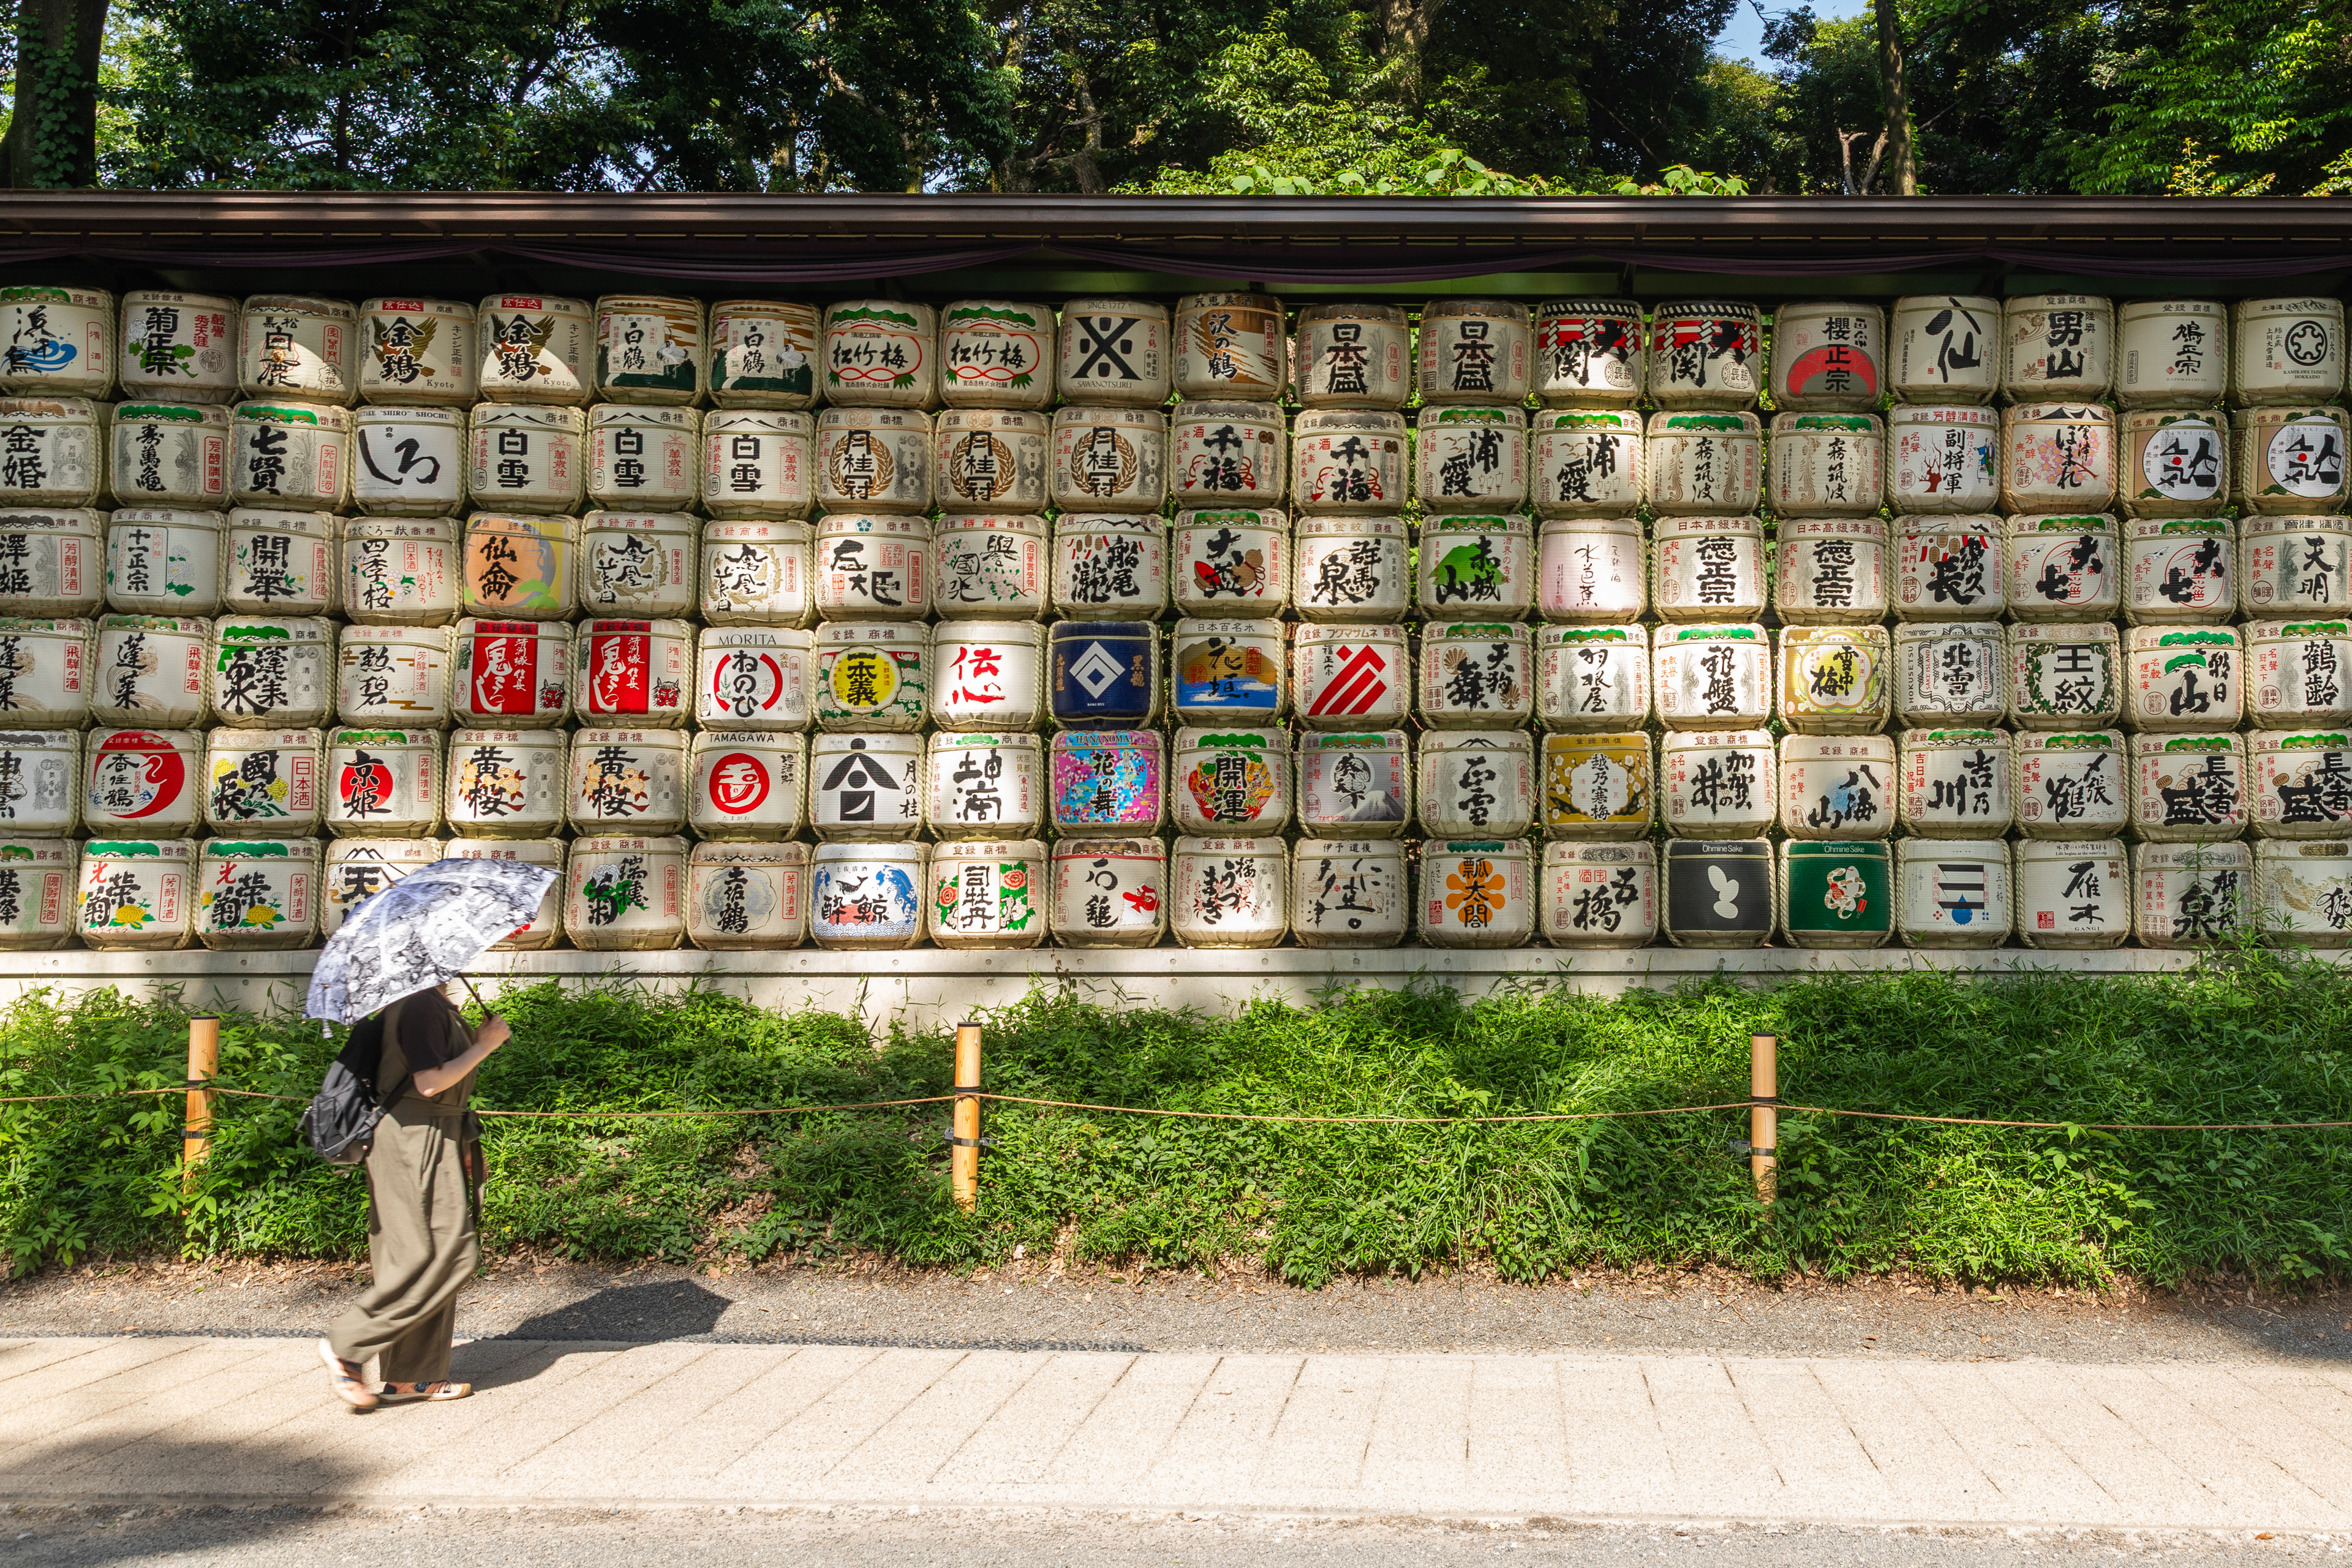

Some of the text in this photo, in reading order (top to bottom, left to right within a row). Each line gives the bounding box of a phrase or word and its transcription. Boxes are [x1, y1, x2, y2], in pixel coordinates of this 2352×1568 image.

[263, 317, 297, 328] 黒松
[385, 300, 422, 311] 京仕込
[502, 298, 540, 309] 京仕込
[1196, 295, 1252, 307] 天恵美酒
[2047, 295, 2086, 305] 登録商標
[2085, 312, 2095, 333] 陸奥
[145, 307, 178, 376] 菊正宗
[258, 326, 300, 387] 白鹿
[451, 325, 462, 365] キンシ正宗
[624, 322, 644, 370] 白鶴
[742, 326, 765, 374] 白鶴
[832, 340, 908, 369] 松竹梅
[950, 338, 1027, 369] 松竹梅
[1208, 313, 1238, 379] 沢の鶴
[1326, 323, 1370, 394] 日本盛
[1452, 320, 1496, 392] 日本盛
[1822, 317, 1851, 392] 櫻正宗
[1901, 331, 1910, 383] 八戸酒造株式会社
[1925, 296, 1983, 382] 八仙
[2046, 311, 2084, 379] 男山
[2172, 321, 2205, 375] 鳩正宗
[427, 379, 454, 388] Kyoto
[543, 377, 571, 386] Kyoto
[1933, 410, 1978, 423] 芳醇清酒
[1, 422, 47, 489] 金婚
[249, 425, 288, 495] 七賢
[359, 429, 440, 485] しろ
[497, 429, 534, 488] 白雪
[614, 428, 650, 488] 白雪
[731, 434, 766, 493] 白雪
[843, 429, 875, 500] 月桂冠
[965, 431, 996, 502] 月桂冠
[1087, 427, 1117, 497] 月桂冠
[1202, 425, 1243, 491] 千福
[1330, 436, 1374, 502] 千福
[1693, 437, 1714, 503] 霧筑波
[1826, 437, 1847, 503] 霧筑波
[1943, 429, 1965, 494] 副将軍
[2056, 424, 2081, 489] ほまれ
[1335, 522, 1362, 532] 金紋
[64, 543, 78, 590] 芳醇清酒
[126, 529, 151, 593] 十一正宗
[244, 535, 296, 603] 開華
[362, 538, 390, 609] 四季桜
[406, 545, 415, 570] 日本酒
[1203, 528, 1246, 598] 大盃
[1436, 535, 1501, 605] 赤城山
[1501, 537, 1512, 585] 酒界の秀峰
[1575, 545, 1600, 607] 水芭蕉
[2297, 535, 2335, 603] 天明
[718, 635, 777, 645] MORITA
[1197, 623, 1255, 633] 日本百名水
[1327, 628, 1378, 639] フクマサムネ
[66, 647, 80, 690] 飛騨の酒
[116, 633, 146, 709] 蓬莱
[417, 650, 427, 691] 芳醇清酒
[475, 639, 512, 714] 鬼ころし
[594, 637, 626, 712] 鬼ころし
[733, 650, 758, 718] ねのひ
[847, 653, 878, 706] 一本義
[950, 647, 1005, 706] 伝心
[1055, 654, 1065, 692] 九頭龍
[1131, 655, 1145, 687] 黒龍
[1208, 637, 1243, 699] 花垣
[1322, 645, 1333, 677] 福正宗
[1579, 648, 1612, 713] 羽根屋
[1942, 643, 1975, 695] 北雪
[2055, 644, 2096, 712] 王紋
[709, 733, 775, 744] TAMAGAWA
[1076, 735, 1134, 744] HANANOMAI
[104, 754, 140, 807] 香住鶴
[295, 761, 309, 806] 日本酒
[343, 750, 392, 819] 京姫
[899, 760, 918, 819] 月の桂
[1090, 751, 1118, 815] 花の舞
[1213, 757, 1253, 823] 開運
[1591, 753, 1610, 821] 越乃寒梅
[1928, 749, 1996, 816] 吉乃川
[1323, 843, 1371, 853] 伊予道後
[1702, 845, 1727, 853] Ohmine
[163, 878, 175, 919] 芳醇清酒
[718, 866, 748, 934] 土佐鶴
[821, 894, 890, 925] 酔鯨
[960, 867, 993, 930] 司牡丹
[1085, 859, 1119, 928] 石鎚
[1463, 857, 1489, 929] 瓢太閤
[1573, 866, 1640, 933] 五橋
[2062, 861, 2105, 925] 雁木
